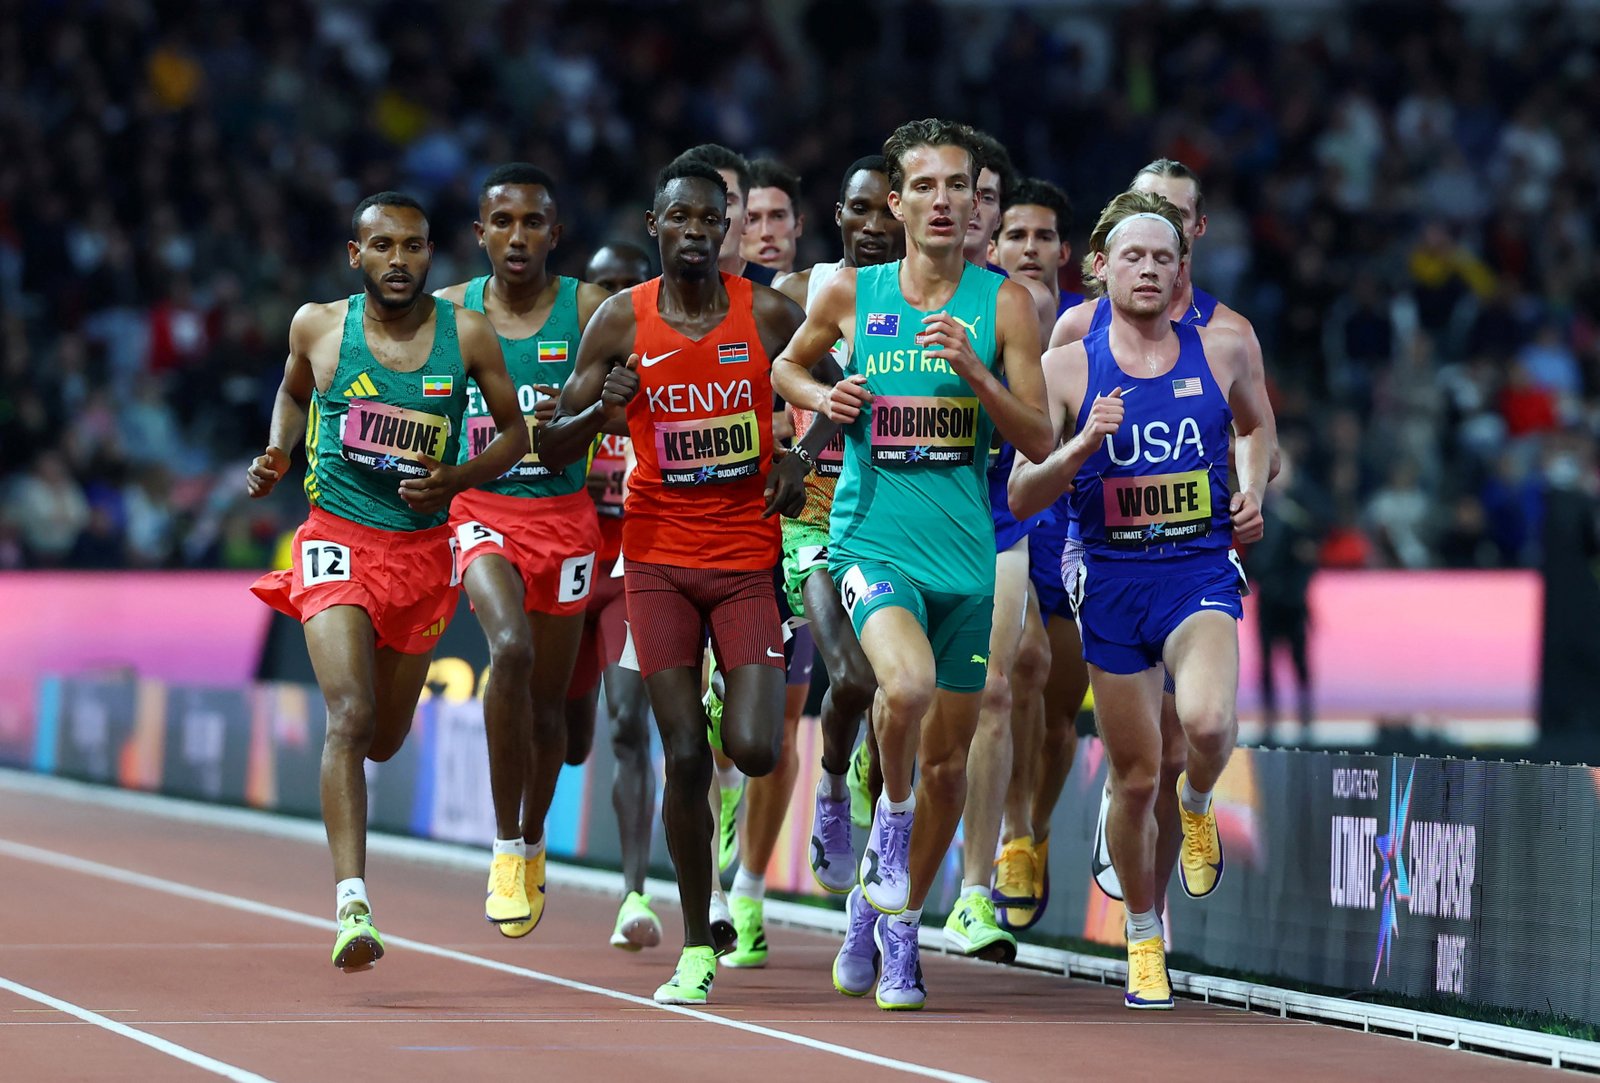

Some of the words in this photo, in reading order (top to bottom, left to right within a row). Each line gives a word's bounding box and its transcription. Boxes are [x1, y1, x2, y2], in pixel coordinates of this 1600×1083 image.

[865, 349, 957, 378] AUSTRA
[646, 379, 752, 413] KENYA
[359, 410, 441, 456] YIHUNE
[877, 406, 974, 438] ROBINSON
[663, 421, 752, 461] KEMBOI
[877, 450, 906, 460] ULTIMATE
[929, 451, 961, 461] BUDAPEST
[1105, 417, 1204, 466] USA
[348, 451, 376, 466] ULTIMATE
[397, 463, 428, 477] BUDAPEST
[667, 473, 695, 483] ULTIMATE
[717, 465, 748, 478] BUDAPEST
[820, 464, 843, 473] ULTIMA
[1116, 481, 1198, 517] WOLFE
[1112, 531, 1142, 539] ULTIMATE
[1165, 525, 1197, 536] BUDAPEST
[306, 546, 344, 578] 12
[572, 564, 586, 596] 5
[844, 581, 856, 610] 6
[1332, 768, 1350, 798] WORLD
[1350, 769, 1378, 800] ATHLETICS
[1330, 816, 1377, 910] ULTIMATE
